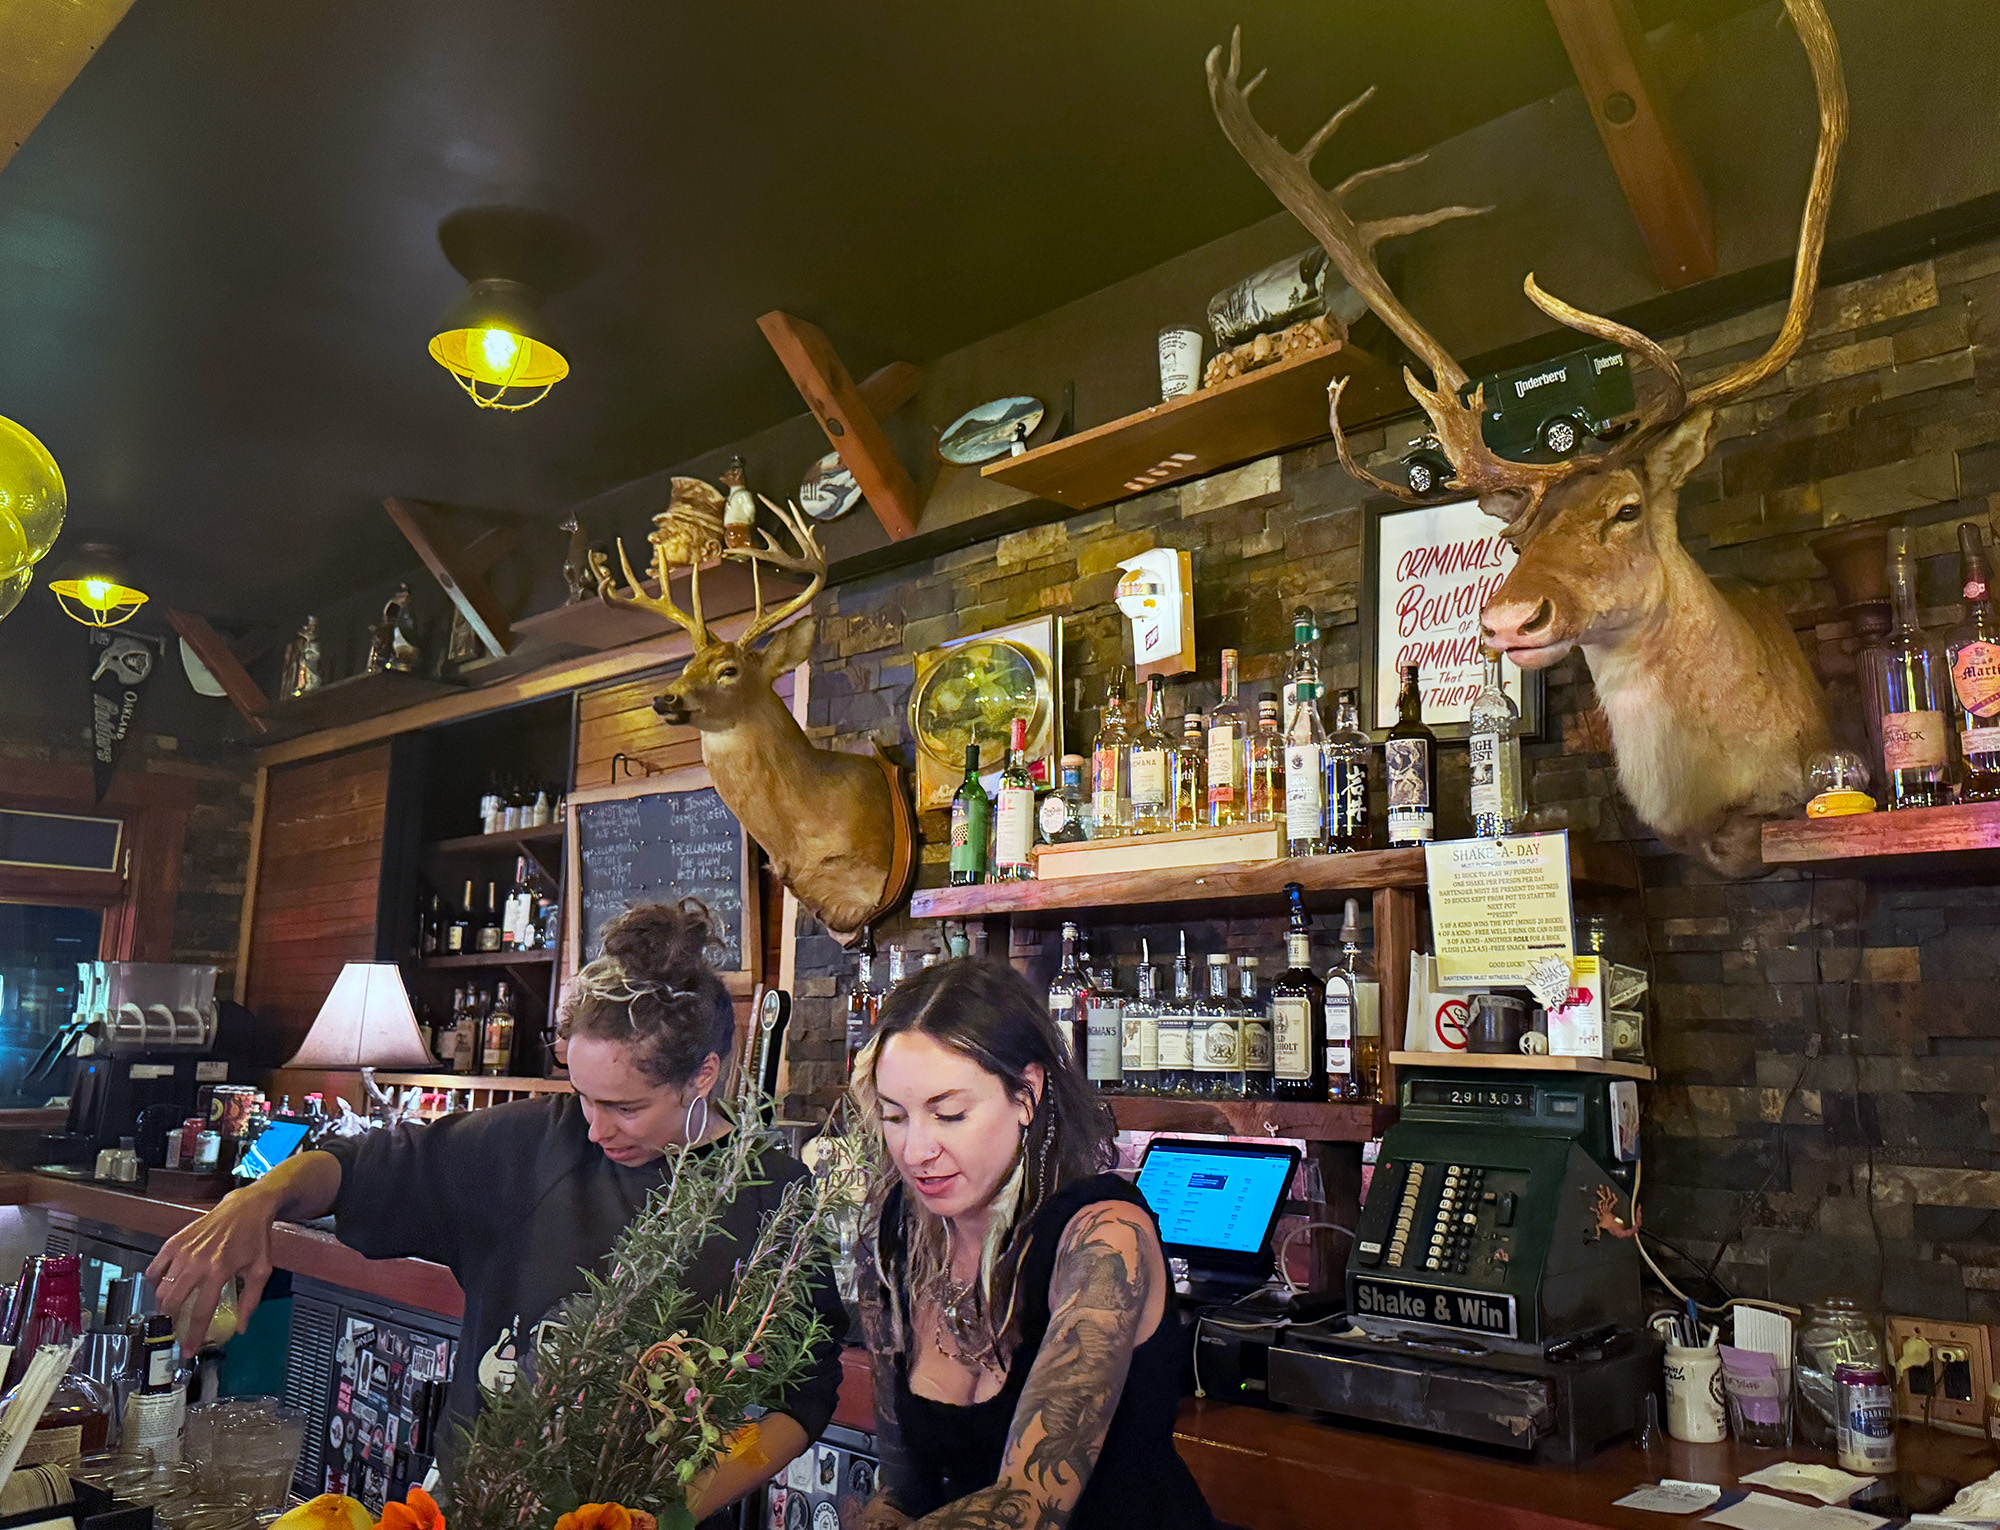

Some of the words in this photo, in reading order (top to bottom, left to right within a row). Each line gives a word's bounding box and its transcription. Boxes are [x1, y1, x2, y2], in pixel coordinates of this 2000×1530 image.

[1593, 353, 1624, 375] Underberg
[1514, 368, 1566, 398] Underberg
[1396, 536, 1507, 582] CRIMINALS
[1396, 573, 1504, 638] Beware
[1395, 636, 1484, 675] CRIMINAL
[1439, 671, 1463, 684] That
[1429, 686, 1464, 708] THIS
[116, 691, 138, 740] OAKLAND
[1452, 847, 1494, 861] SHAKE
[1517, 843, 1541, 857] DAY
[1488, 870, 1503, 878] PLAY
[1513, 868, 1544, 876] PURCHASE
[1439, 888, 1475, 897] BARTENDER
[1500, 885, 1527, 893] PRESENT
[1527, 884, 1536, 892] TO
[1452, 880, 1465, 888] ONE
[1498, 878, 1522, 886] PERSON
[1526, 892, 1545, 900] START
[1487, 903, 1503, 911] NEXT
[1504, 902, 1516, 910] POT
[1456, 929, 1471, 937] KIND
[1491, 927, 1508, 935] WELL
[1508, 926, 1527, 934] DRINK
[1484, 936, 1513, 944] ANOTHER
[1506, 944, 1526, 952] SNACK
[1488, 960, 1506, 968] GOOD
[1535, 963, 1569, 987] SHAKE
[1358, 1285, 1426, 1318] Shake
[1434, 1295, 1450, 1321] &
[1457, 1297, 1504, 1329] Win
